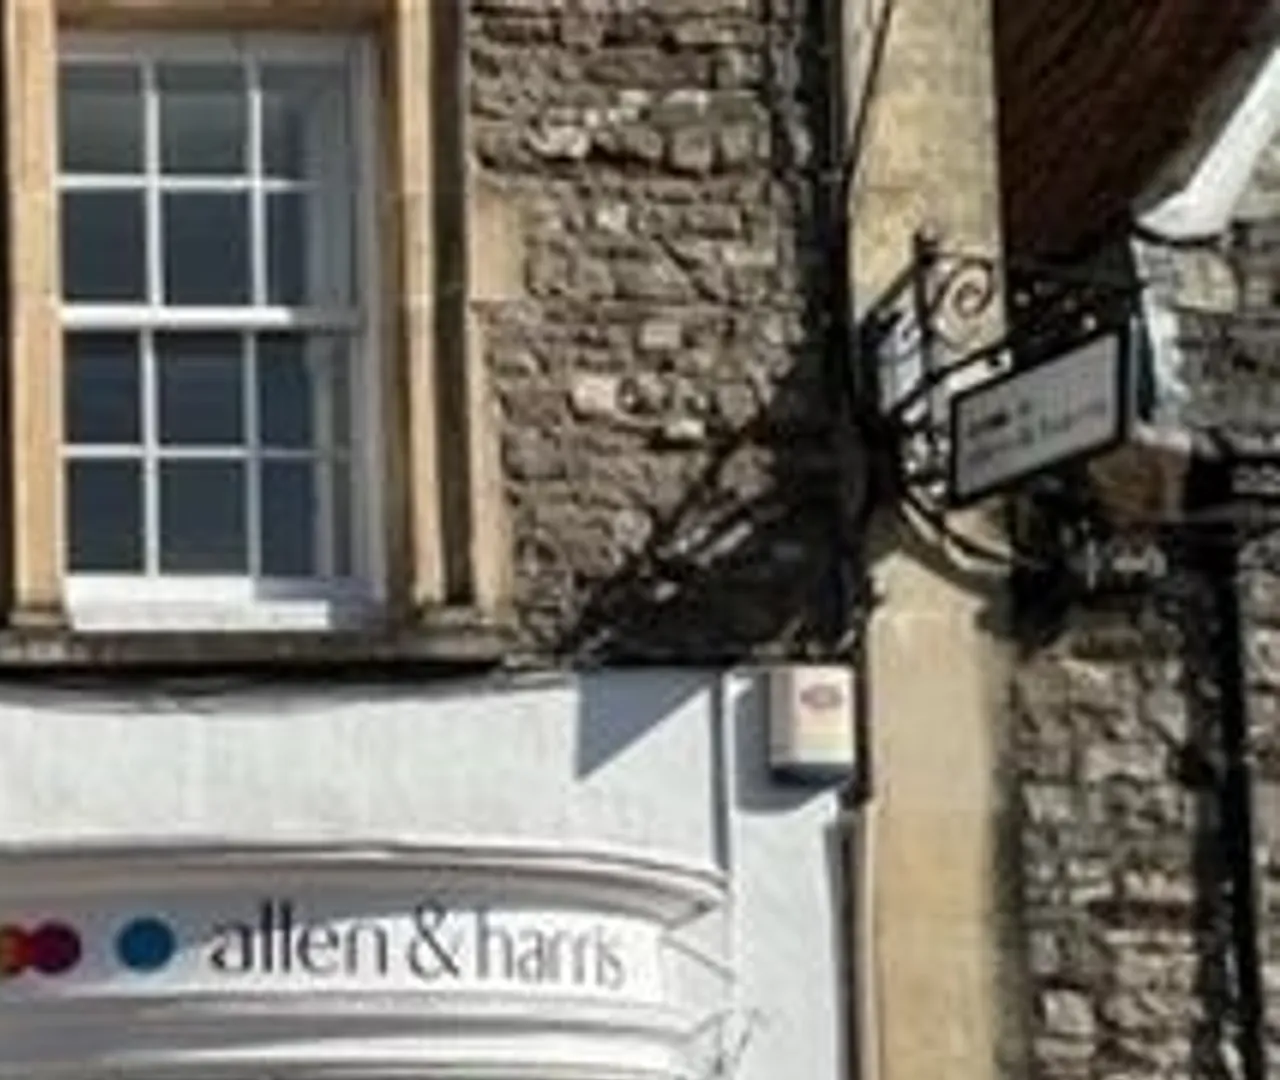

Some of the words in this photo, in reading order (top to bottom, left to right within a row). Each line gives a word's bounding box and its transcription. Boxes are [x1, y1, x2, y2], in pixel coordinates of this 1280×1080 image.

[209, 897, 388, 978] allen
[405, 897, 460, 981] &
[475, 903, 627, 991] harris
